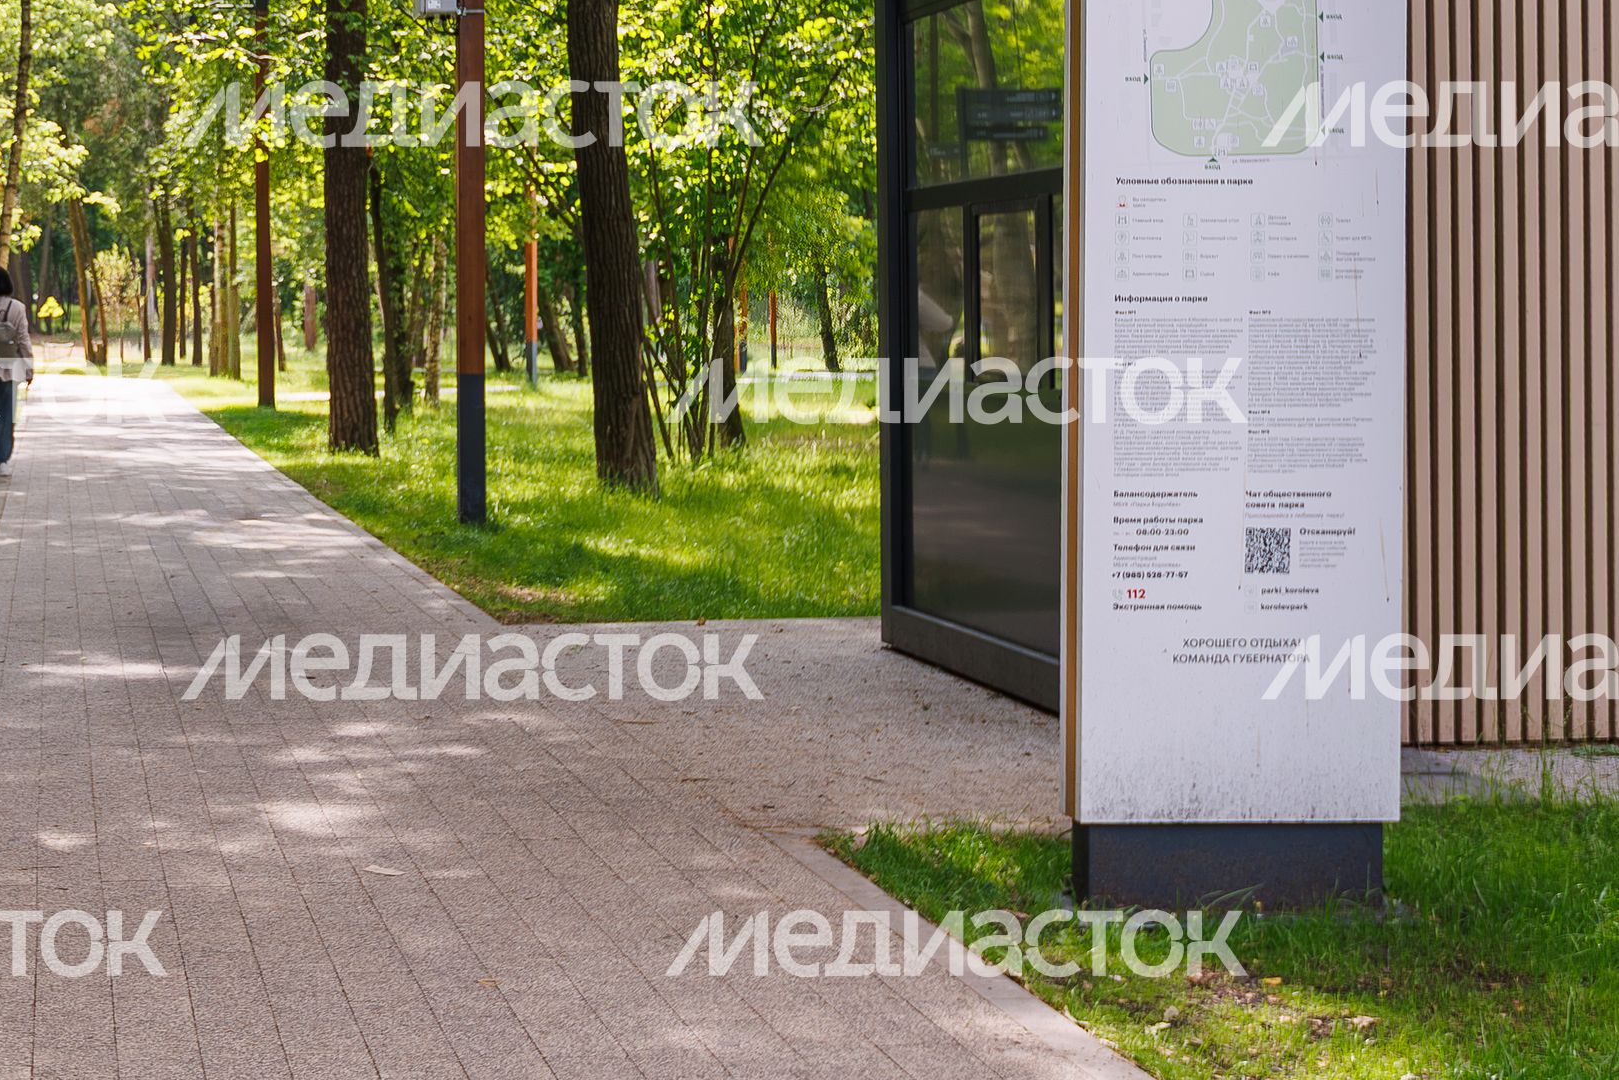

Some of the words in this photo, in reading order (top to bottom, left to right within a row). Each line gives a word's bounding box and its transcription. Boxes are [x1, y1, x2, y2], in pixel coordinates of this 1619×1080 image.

[1116, 177, 1159, 185] Условные
[1161, 176, 1218, 185] обозначения
[1227, 178, 1253, 187] парке
[1114, 293, 1173, 304] Информация
[1181, 295, 1208, 304] парке
[1113, 490, 1198, 499] Балансодержатель
[1113, 516, 1142, 525] Время
[1143, 515, 1176, 525] работы
[1177, 517, 1203, 526] парка
[1113, 543, 1151, 553] Телефон
[1152, 545, 1169, 553] для
[1126, 588, 1146, 599] 112
[1182, 638, 1247, 648] ХОРОШЕГО
[1172, 654, 1230, 664] КОМАНДА
[1232, 653, 1310, 664] ГУБЕРНАТОРА
